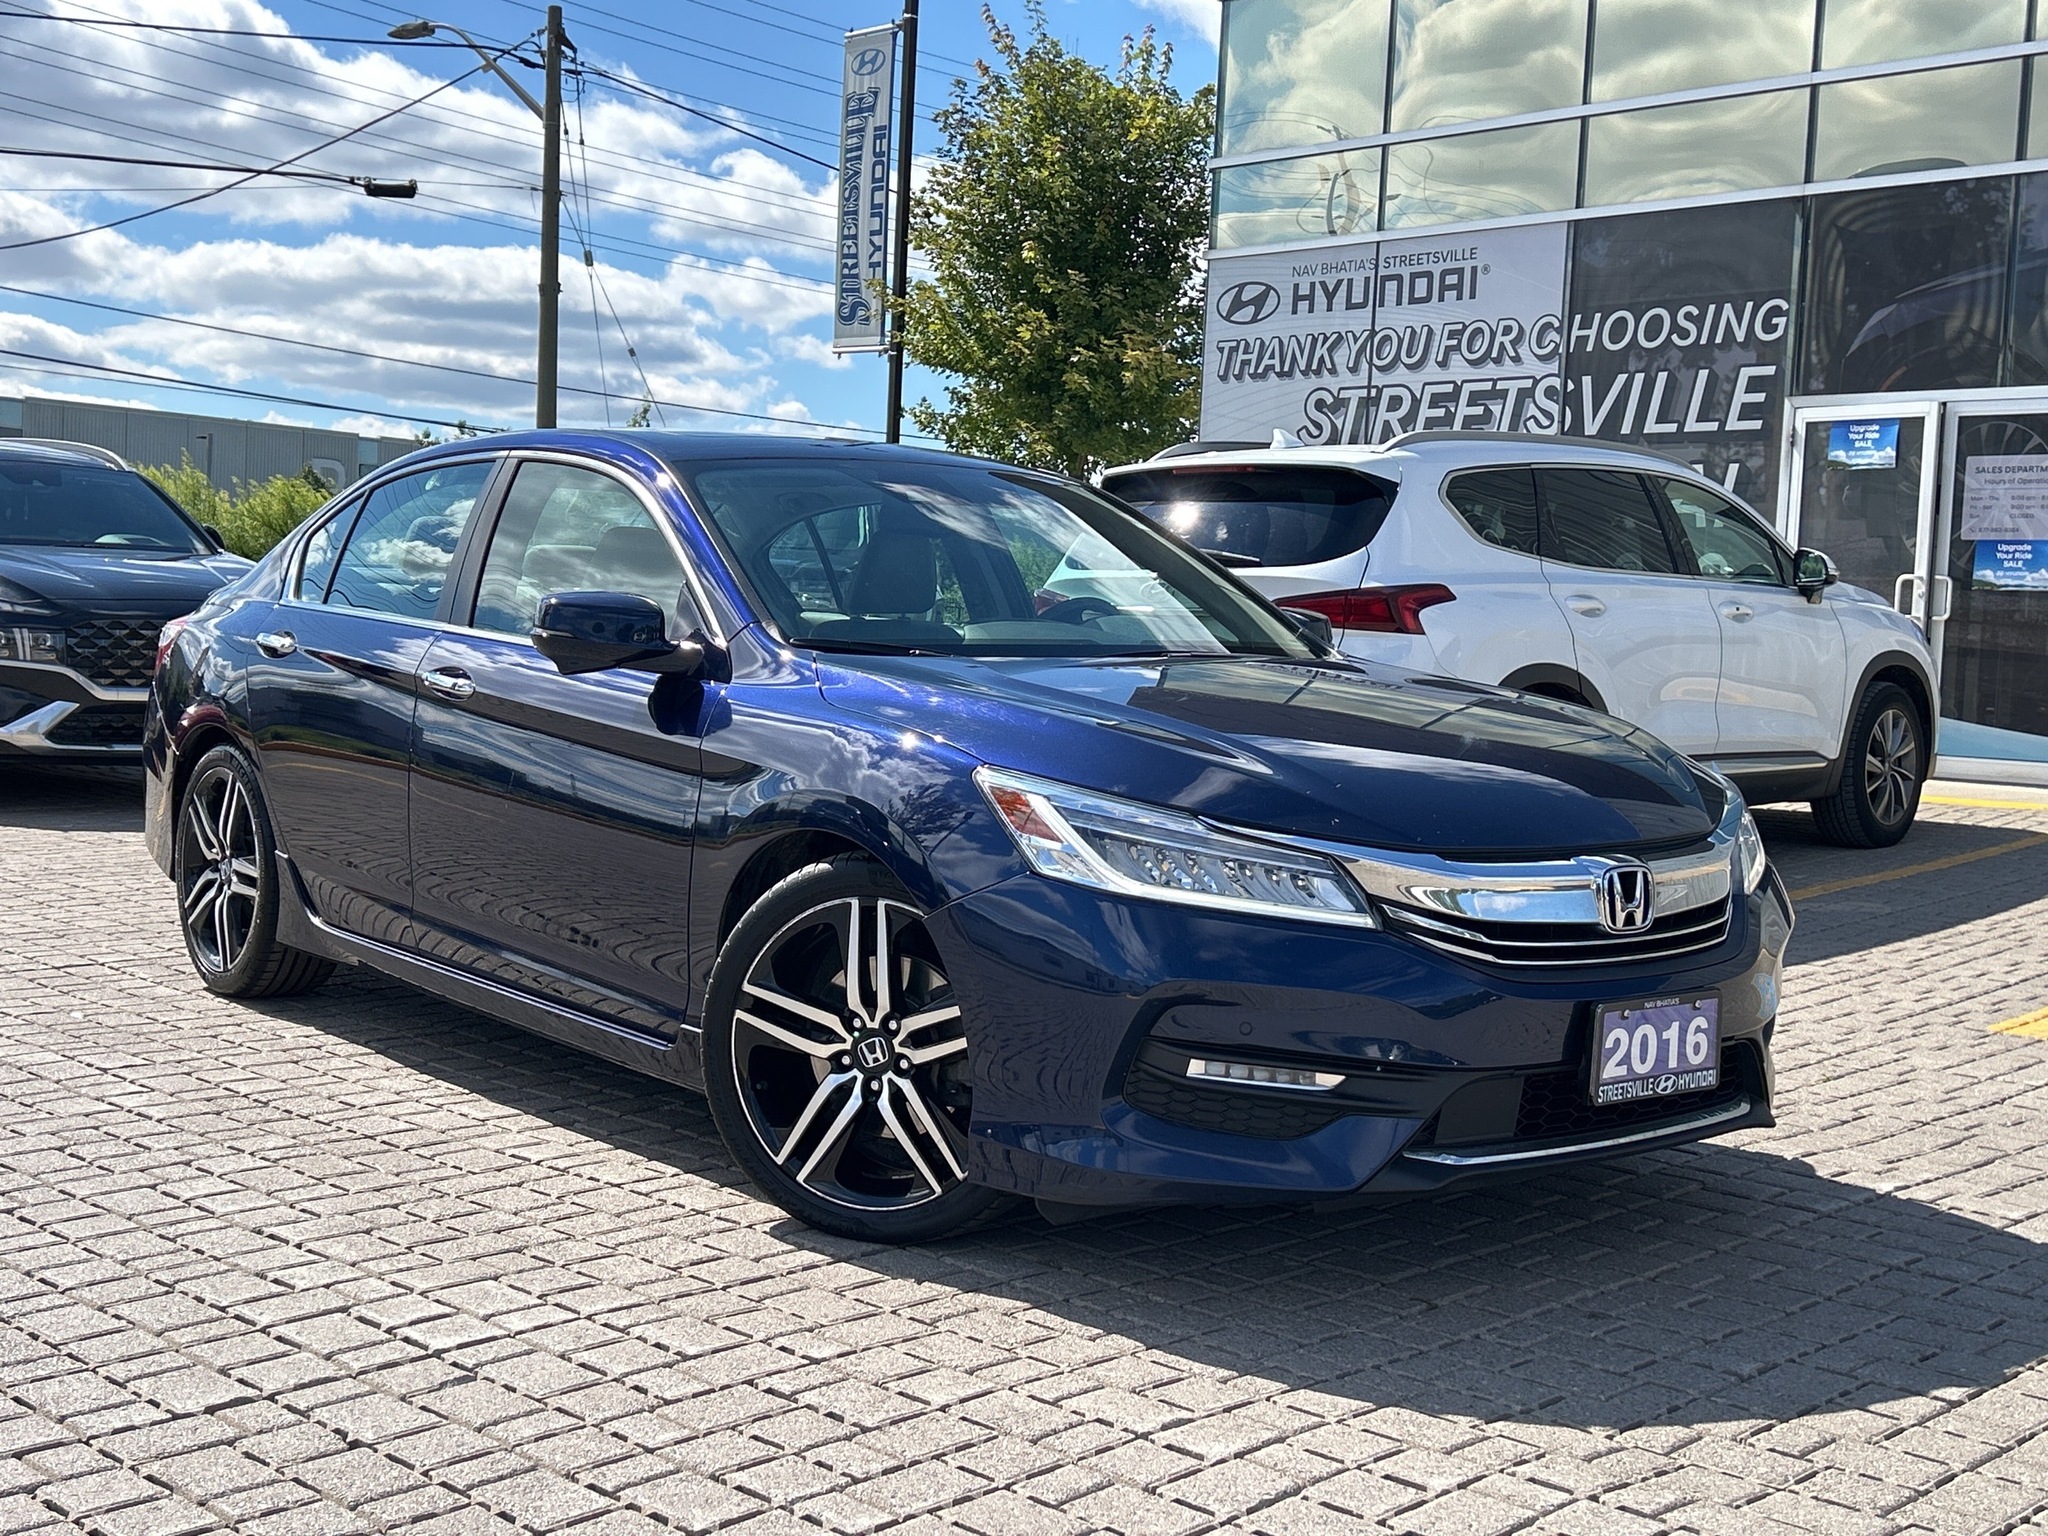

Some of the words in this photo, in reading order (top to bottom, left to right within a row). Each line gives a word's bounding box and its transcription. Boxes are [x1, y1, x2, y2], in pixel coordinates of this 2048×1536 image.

[838, 86, 880, 326] STREETSVILLE
[868, 125, 887, 279] HYUNDAI
[1292, 264, 1318, 278] NAV
[1320, 257, 1377, 275] BHATIA'S
[1383, 247, 1478, 269] STREETSVILLE
[1217, 331, 1343, 382] THANK
[1345, 325, 1434, 373] YOU
[1435, 317, 1524, 369] FOR
[1528, 298, 1790, 358] CHOOSING
[1297, 365, 1782, 445] STREETSVILLE
[1849, 424, 1880, 432] Upgrade
[1864, 431, 1880, 439] Ride
[1854, 440, 1873, 448] SALE
[1975, 466, 2003, 474] SALES
[2004, 465, 2048, 474] DEPARTM
[1984, 478, 2006, 486] Hours
[1997, 543, 2032, 552] Upgrade
[2003, 560, 2024, 568] SALE
[1602, 1016, 1709, 1079] 2016
[1597, 1078, 1654, 1103] STREETSVILLE
[1677, 1069, 1717, 1091] HYUNDAI
